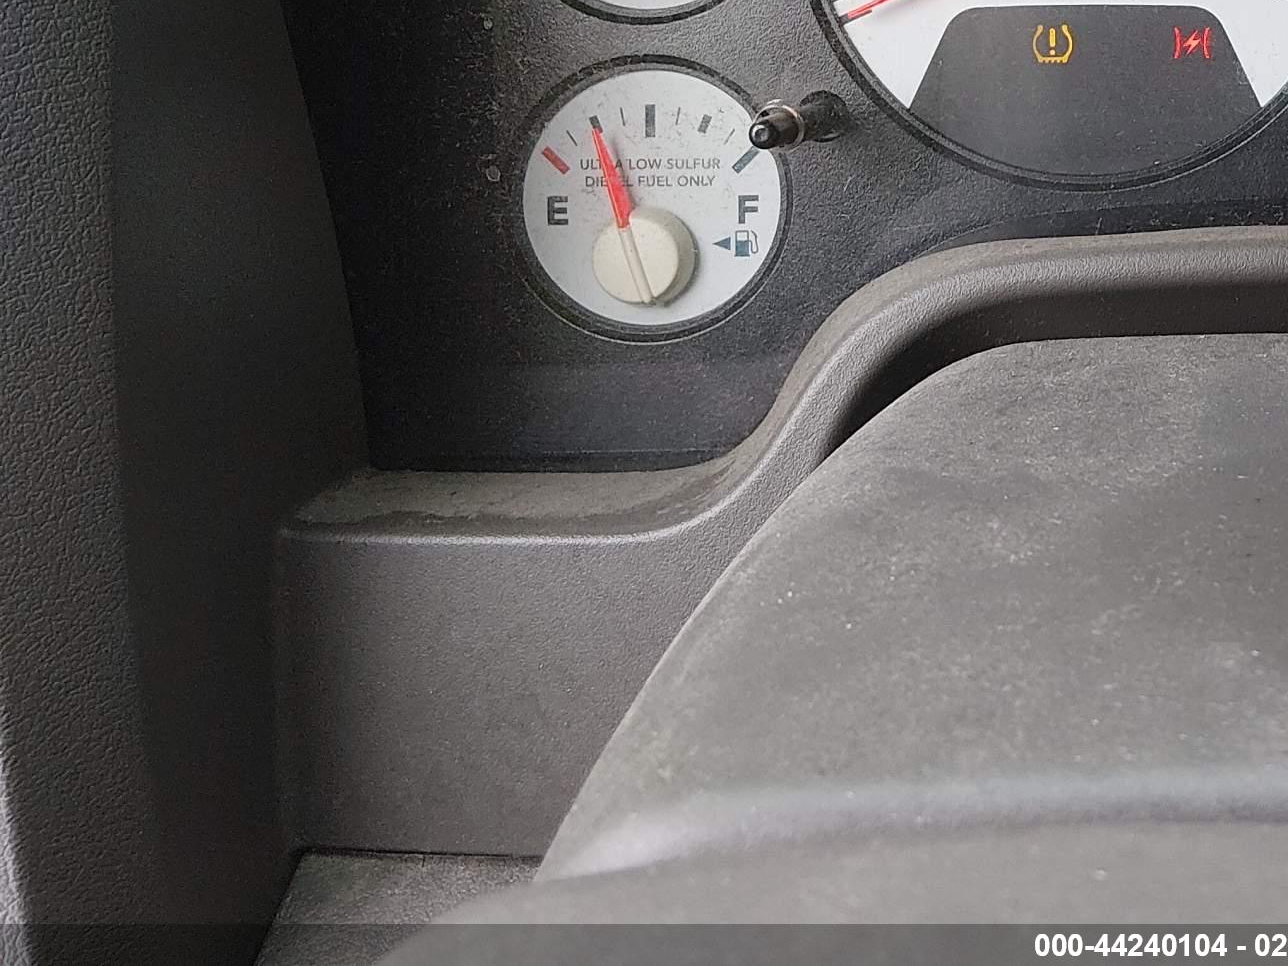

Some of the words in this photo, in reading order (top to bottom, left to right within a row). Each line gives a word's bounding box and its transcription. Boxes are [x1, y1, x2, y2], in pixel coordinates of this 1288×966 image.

[579, 157, 625, 171] ULTA
[628, 158, 662, 171] LOW
[666, 157, 721, 171] SULFUR
[637, 174, 673, 188] FUEL
[676, 174, 716, 187] ONLY
[546, 195, 569, 227] E
[737, 194, 760, 225] F
